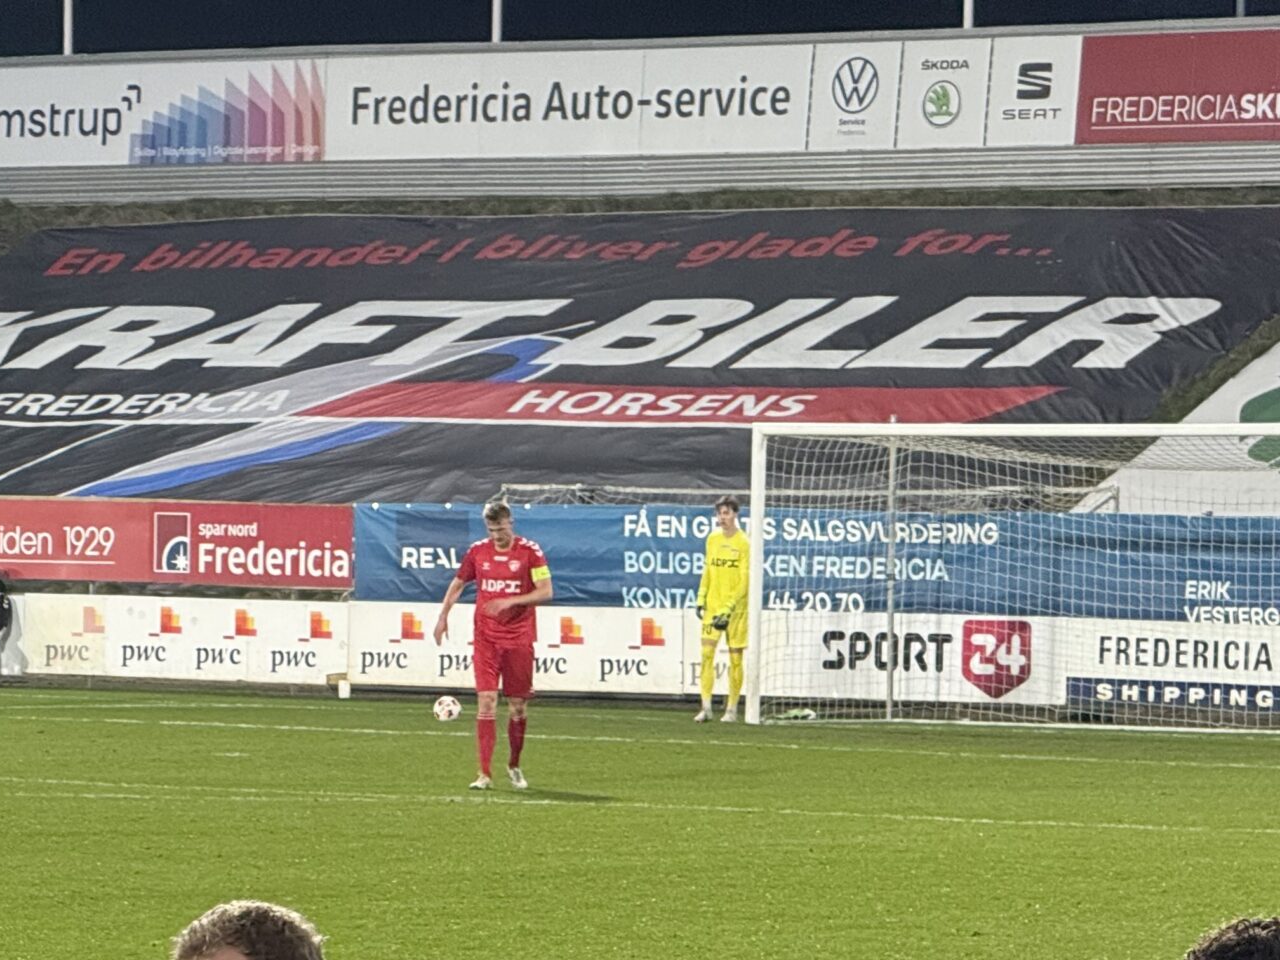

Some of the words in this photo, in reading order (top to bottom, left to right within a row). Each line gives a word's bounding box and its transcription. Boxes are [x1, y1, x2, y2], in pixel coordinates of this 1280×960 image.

[351, 81, 531, 125] Fredericia
[543, 75, 791, 121] Auto-service
[1002, 107, 1061, 120] SEAT
[45, 248, 126, 277] En
[131, 237, 439, 274] bilhandel
[474, 233, 679, 263] bliver
[675, 229, 879, 269] glade
[527, 295, 1222, 369] BILER
[507, 389, 819, 418] HORSENS
[624, 505, 657, 538] FÅ
[661, 515, 687, 539] EN
[63, 525, 115, 557] 1929
[198, 540, 349, 578] Fredericia
[812, 555, 950, 582] FREDERICIA
[804, 591, 832, 613] 20
[835, 592, 865, 614] 70
[1184, 579, 1231, 601] ERIK
[45, 644, 89, 666] pwc
[122, 645, 166, 667] pwc
[195, 646, 242, 670] pwc
[271, 648, 317, 672] pwc
[361, 650, 408, 674] pwc
[822, 630, 953, 674] SPORT
[969, 632, 1026, 676] 24
[1098, 634, 1273, 672] FREDERICIA
[600, 654, 649, 682] pwc
[1096, 683, 1274, 708] SHIPPING
